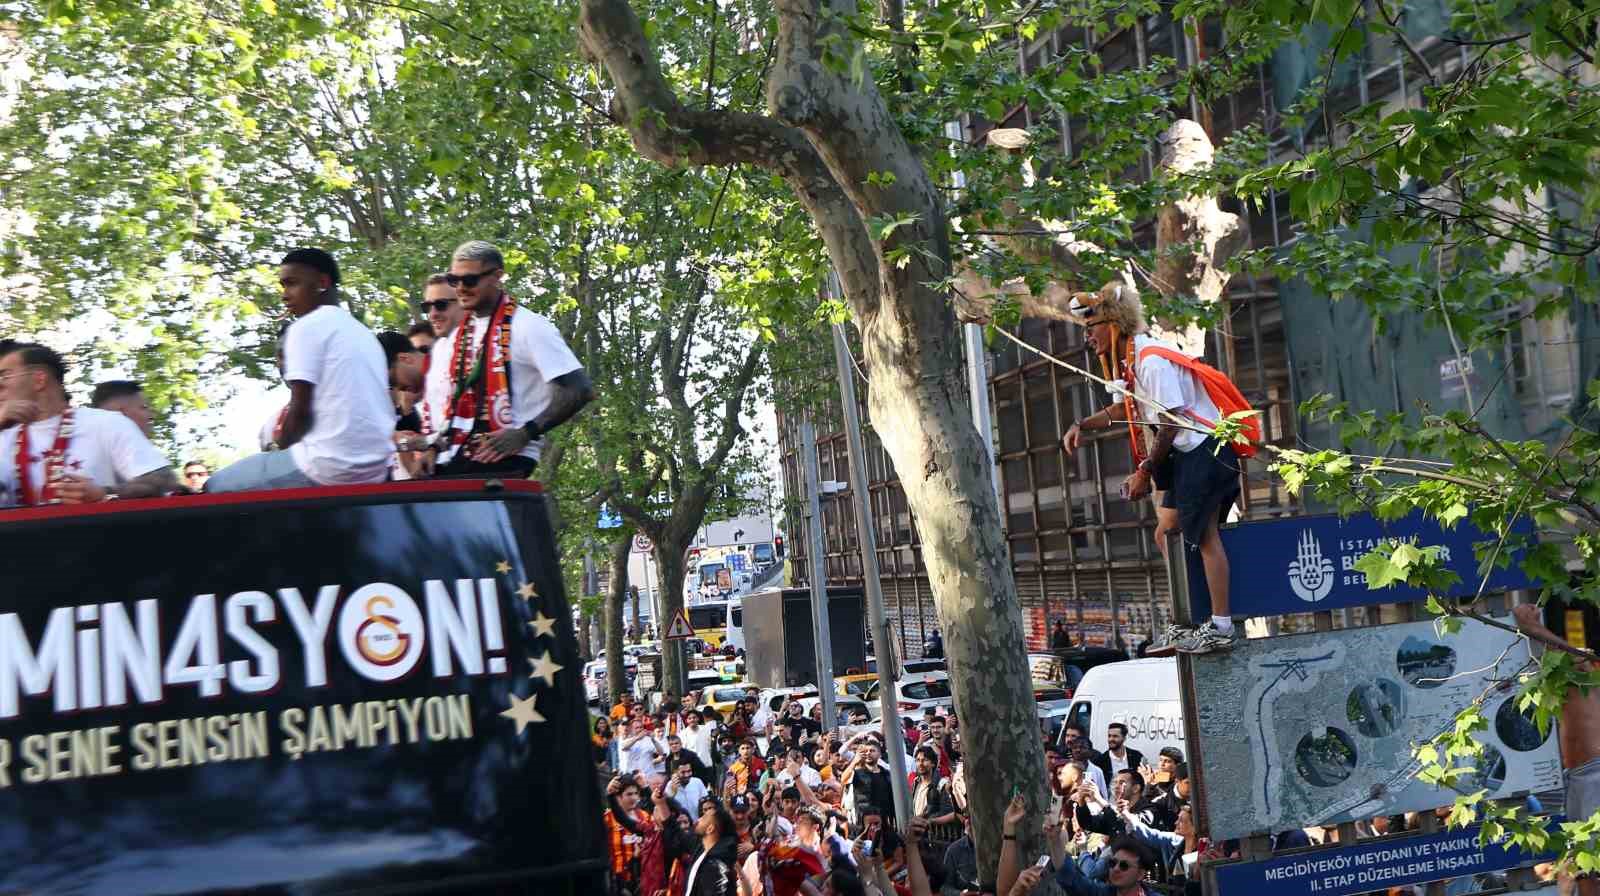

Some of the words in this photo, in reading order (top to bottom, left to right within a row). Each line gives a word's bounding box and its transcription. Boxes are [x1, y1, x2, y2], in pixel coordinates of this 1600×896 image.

[21, 725, 122, 783] SENE
[1265, 855, 1352, 881] MECİDİYEKÖY
[1355, 844, 1413, 866] MEYDANI
[1414, 844, 1431, 857] VE
[1432, 837, 1470, 854] YAKIN
[1324, 873, 1355, 889] ETAP
[1358, 860, 1434, 884] DÜZENLEME
